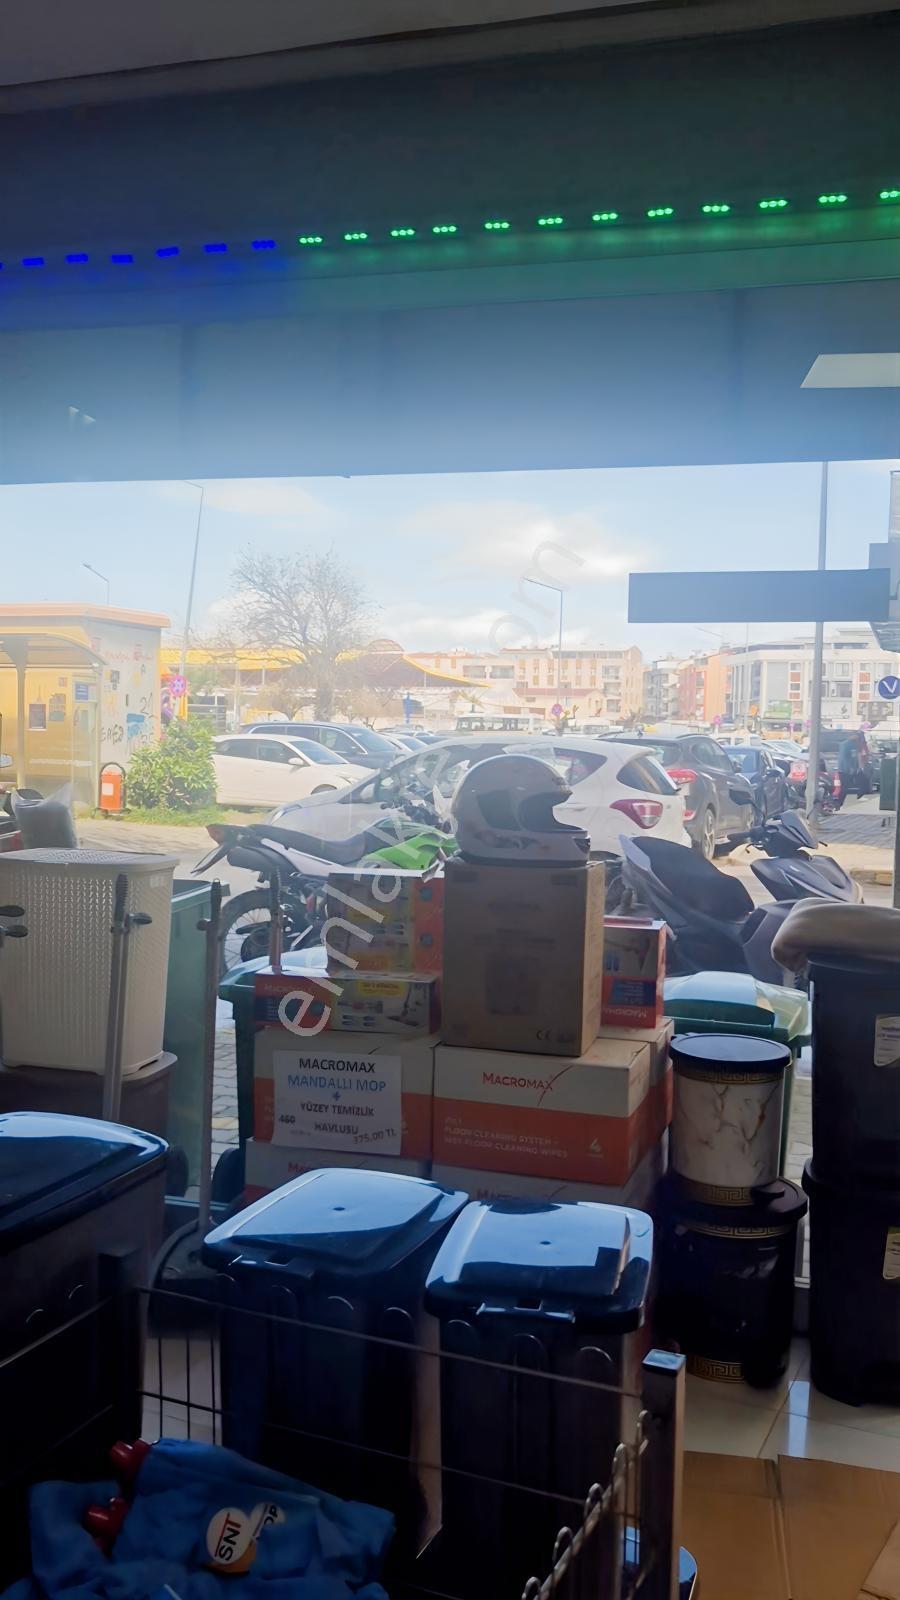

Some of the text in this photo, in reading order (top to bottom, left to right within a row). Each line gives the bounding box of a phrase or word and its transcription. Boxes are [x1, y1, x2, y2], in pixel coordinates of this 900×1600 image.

[299, 1058, 376, 1073] MACROMAX
[288, 1074, 386, 1092] MANDALLI MOP
[482, 1072, 553, 1091] MACROMAX
[301, 1102, 329, 1113] YÜZEY
